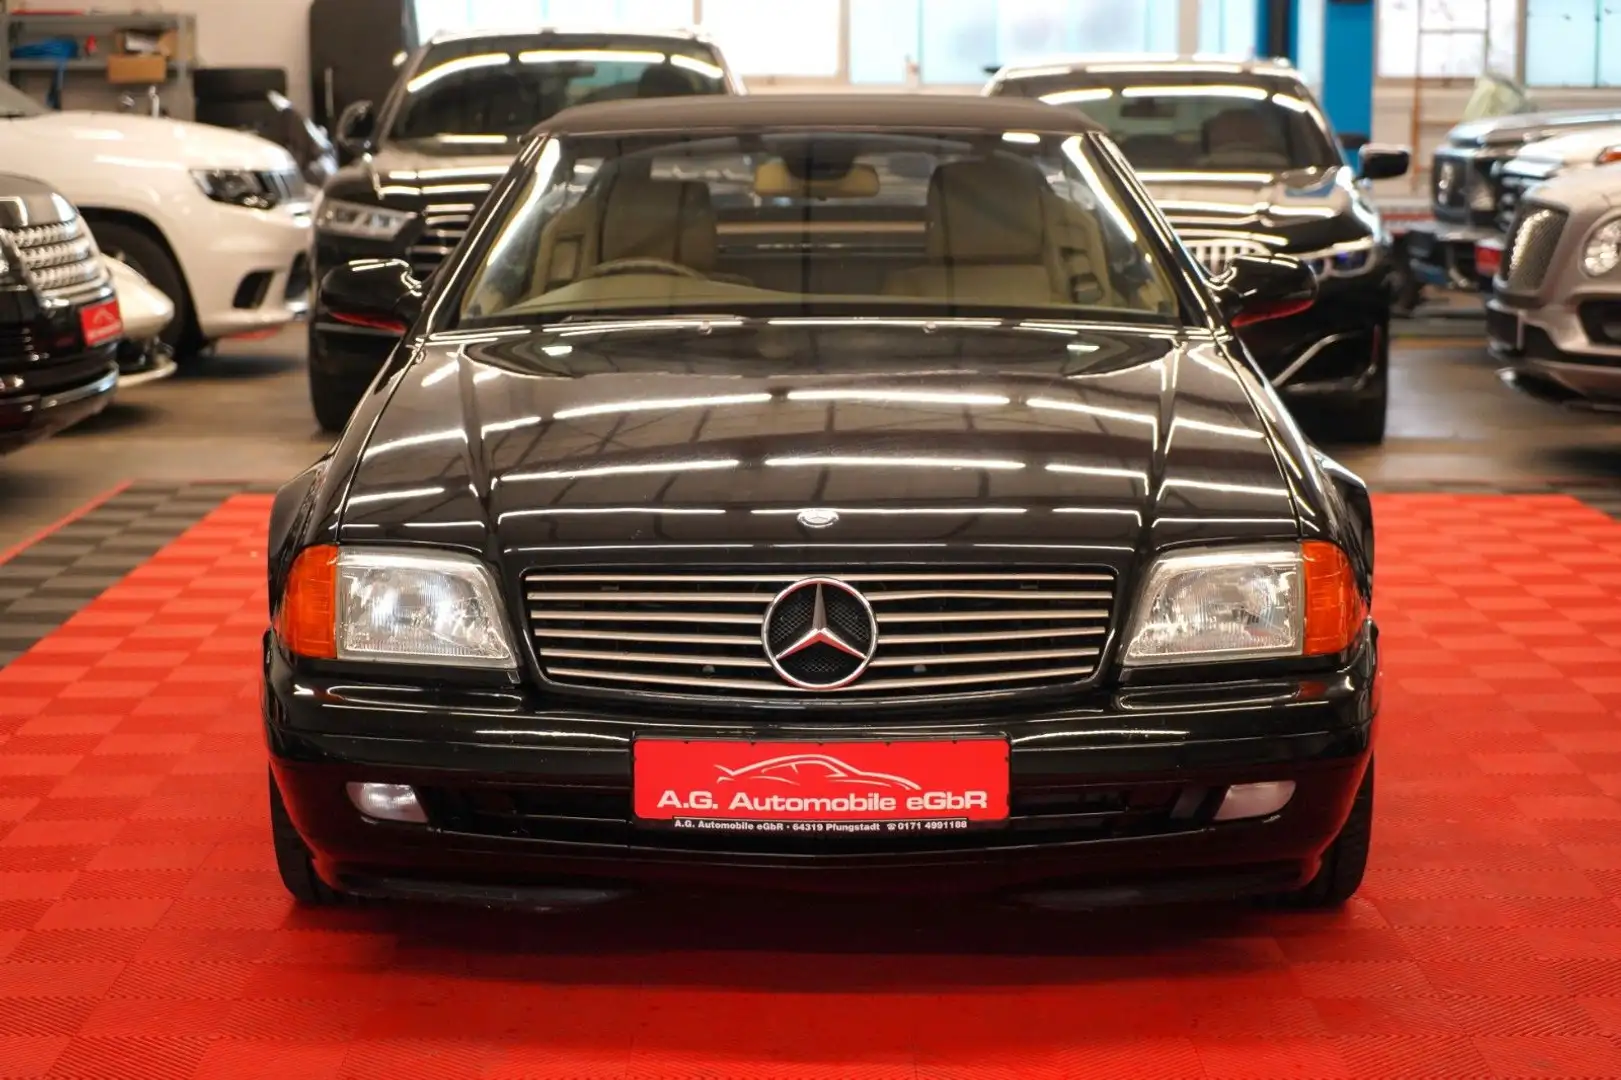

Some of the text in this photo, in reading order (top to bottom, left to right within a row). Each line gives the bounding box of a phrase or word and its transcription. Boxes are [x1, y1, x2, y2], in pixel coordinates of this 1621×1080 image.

[656, 789, 988, 812] A.G. Automobile eGbR
[674, 819, 695, 828] A.G.
[698, 820, 754, 831] Automobile
[756, 822, 784, 831] eGbR
[792, 823, 823, 831] 64319
[826, 822, 881, 833] Pfungstadt
